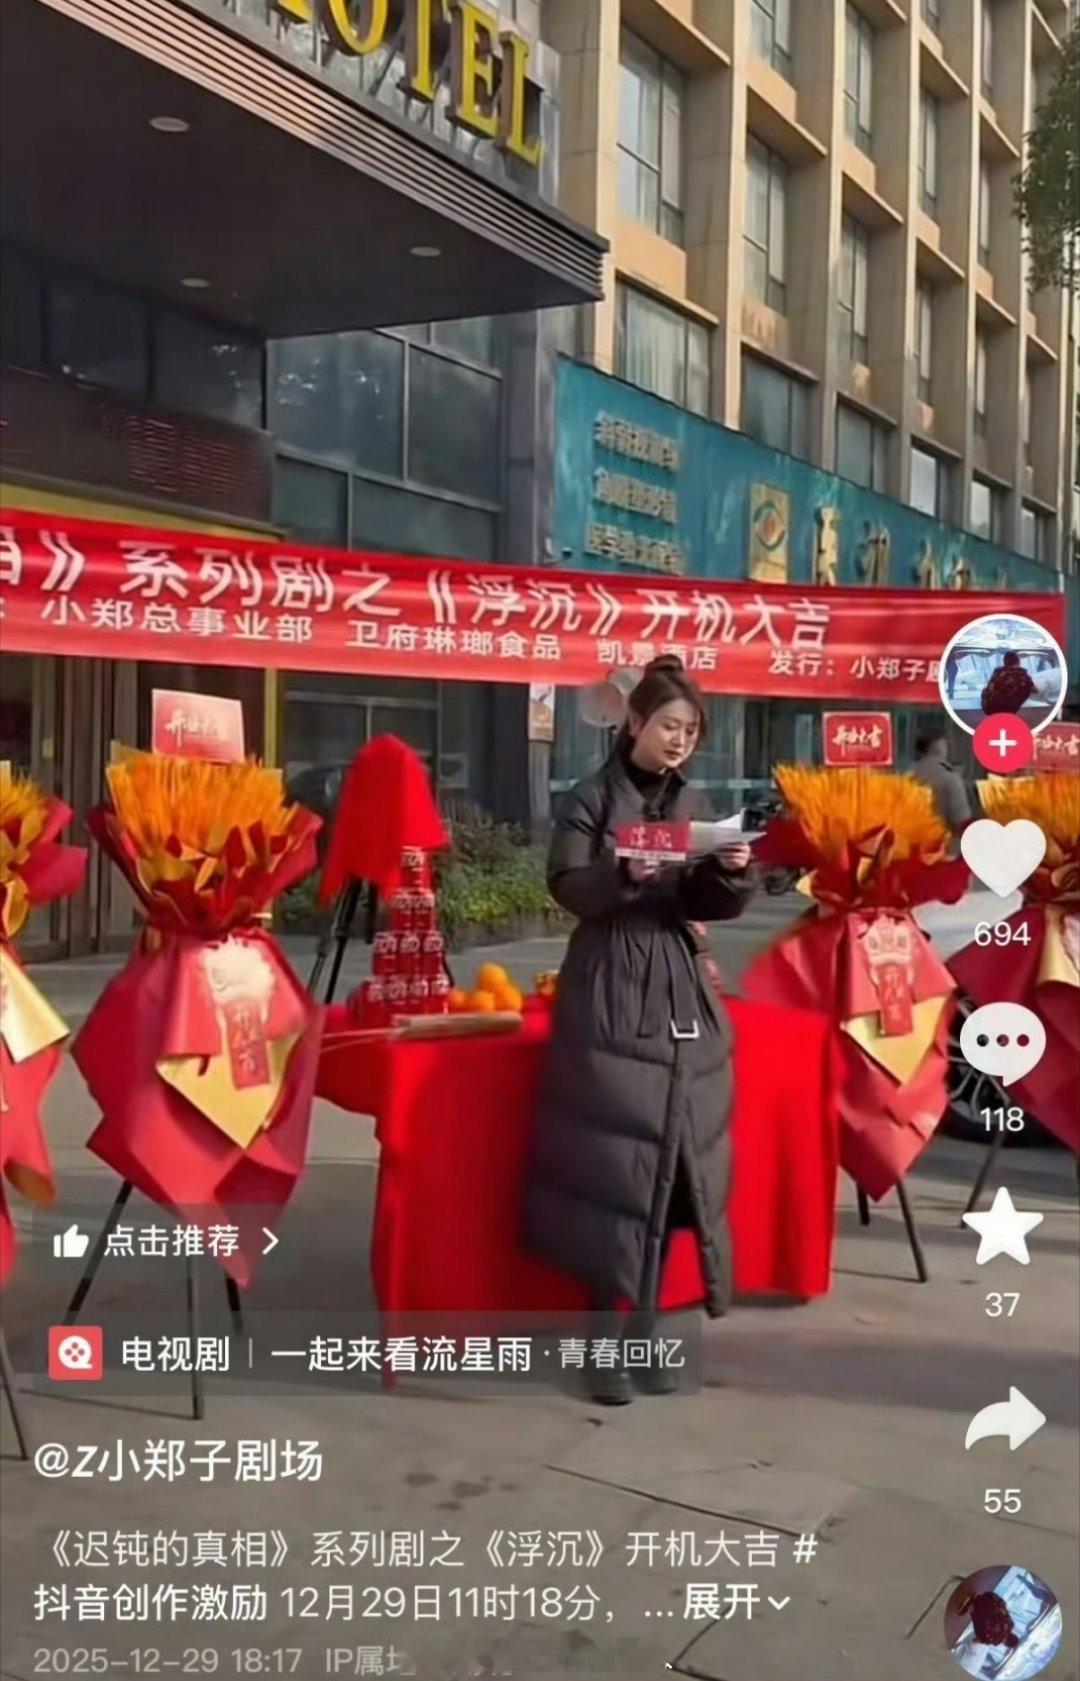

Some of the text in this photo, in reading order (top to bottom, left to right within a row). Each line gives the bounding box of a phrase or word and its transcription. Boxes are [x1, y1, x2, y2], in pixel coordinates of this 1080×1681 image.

[273, 0, 541, 166] OTEL
[41, 595, 313, 645] 小郑总事业部
